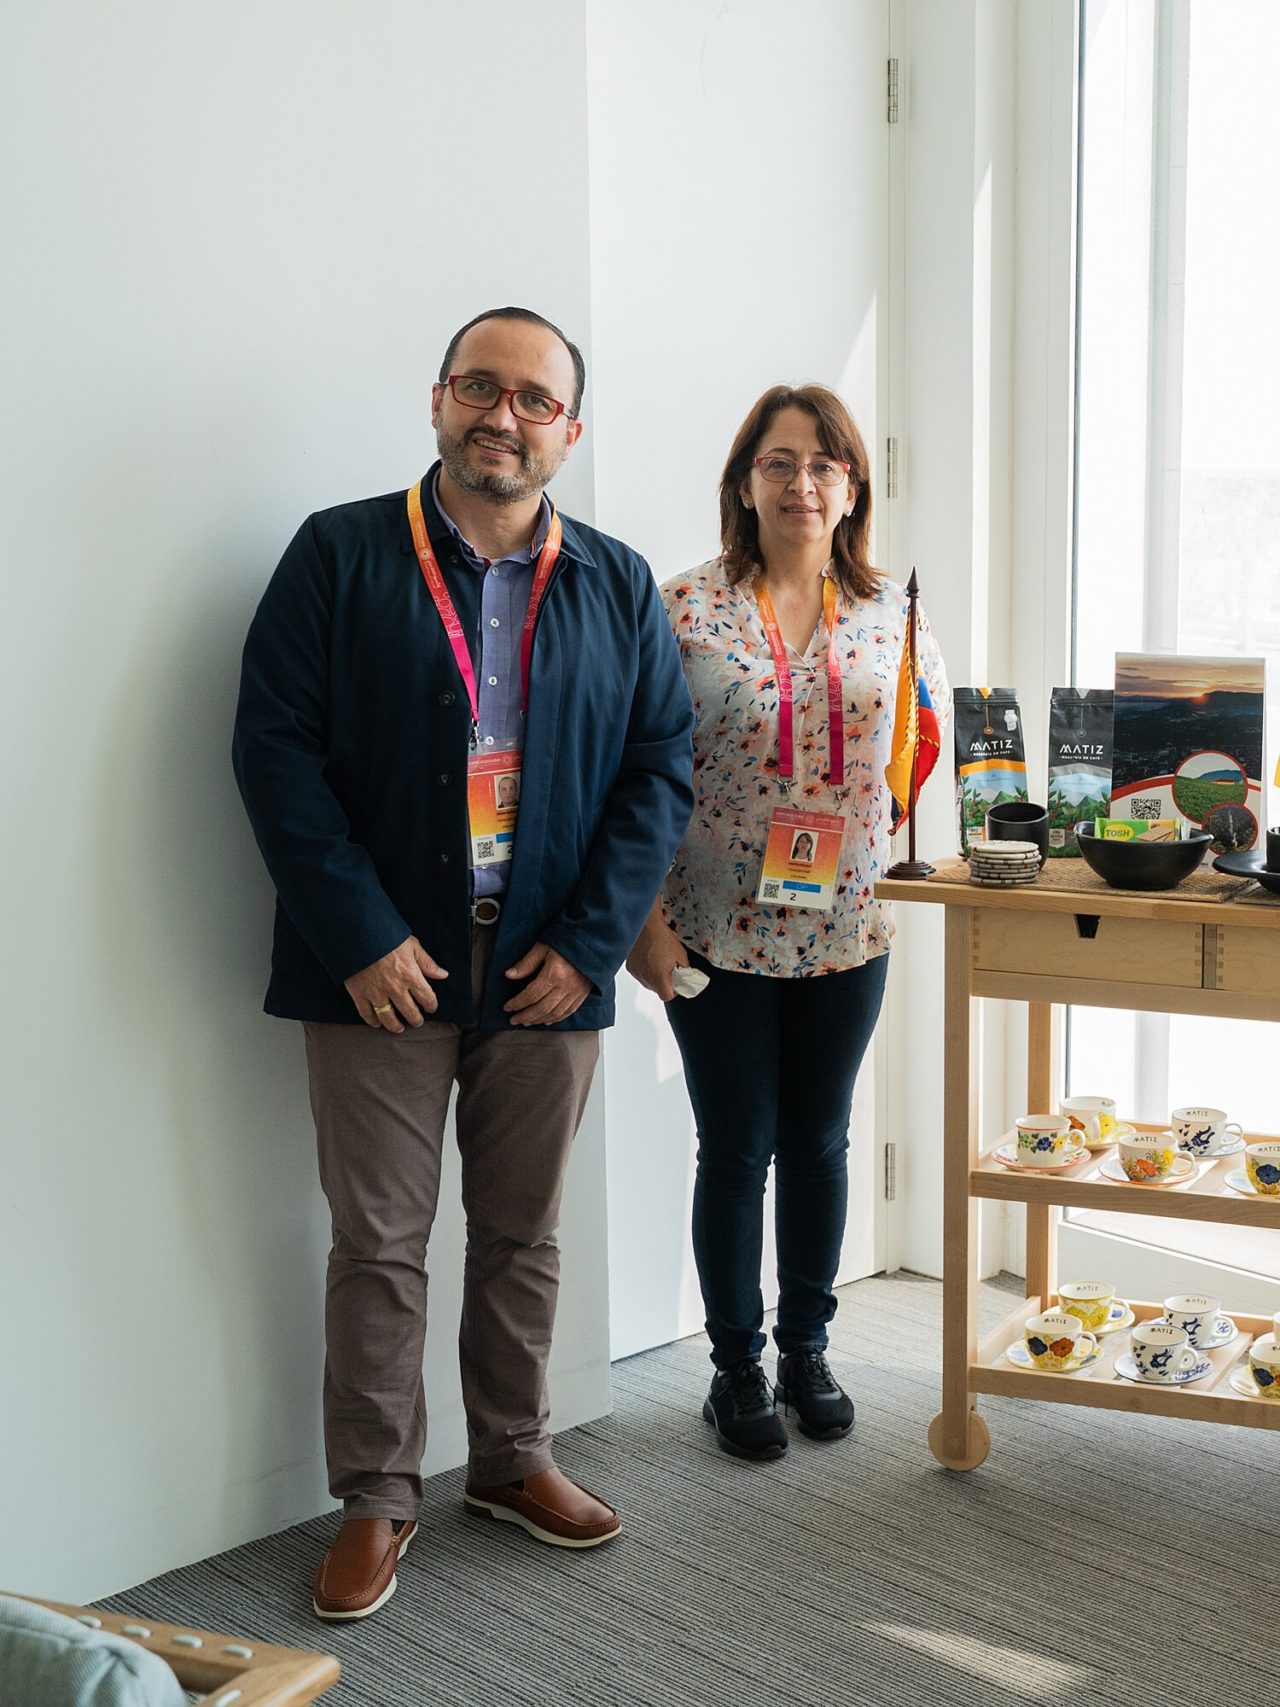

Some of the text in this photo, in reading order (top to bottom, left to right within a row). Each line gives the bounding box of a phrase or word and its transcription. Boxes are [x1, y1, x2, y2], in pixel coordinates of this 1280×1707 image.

[970, 739, 1013, 752] MATIZ
[1059, 744, 1104, 755] MATIZ
[1106, 829, 1130, 838] TOSH
[789, 892, 797, 901] 2
[1043, 1317, 1067, 1325] MATIZ
[1150, 1327, 1174, 1335] MATIZ
